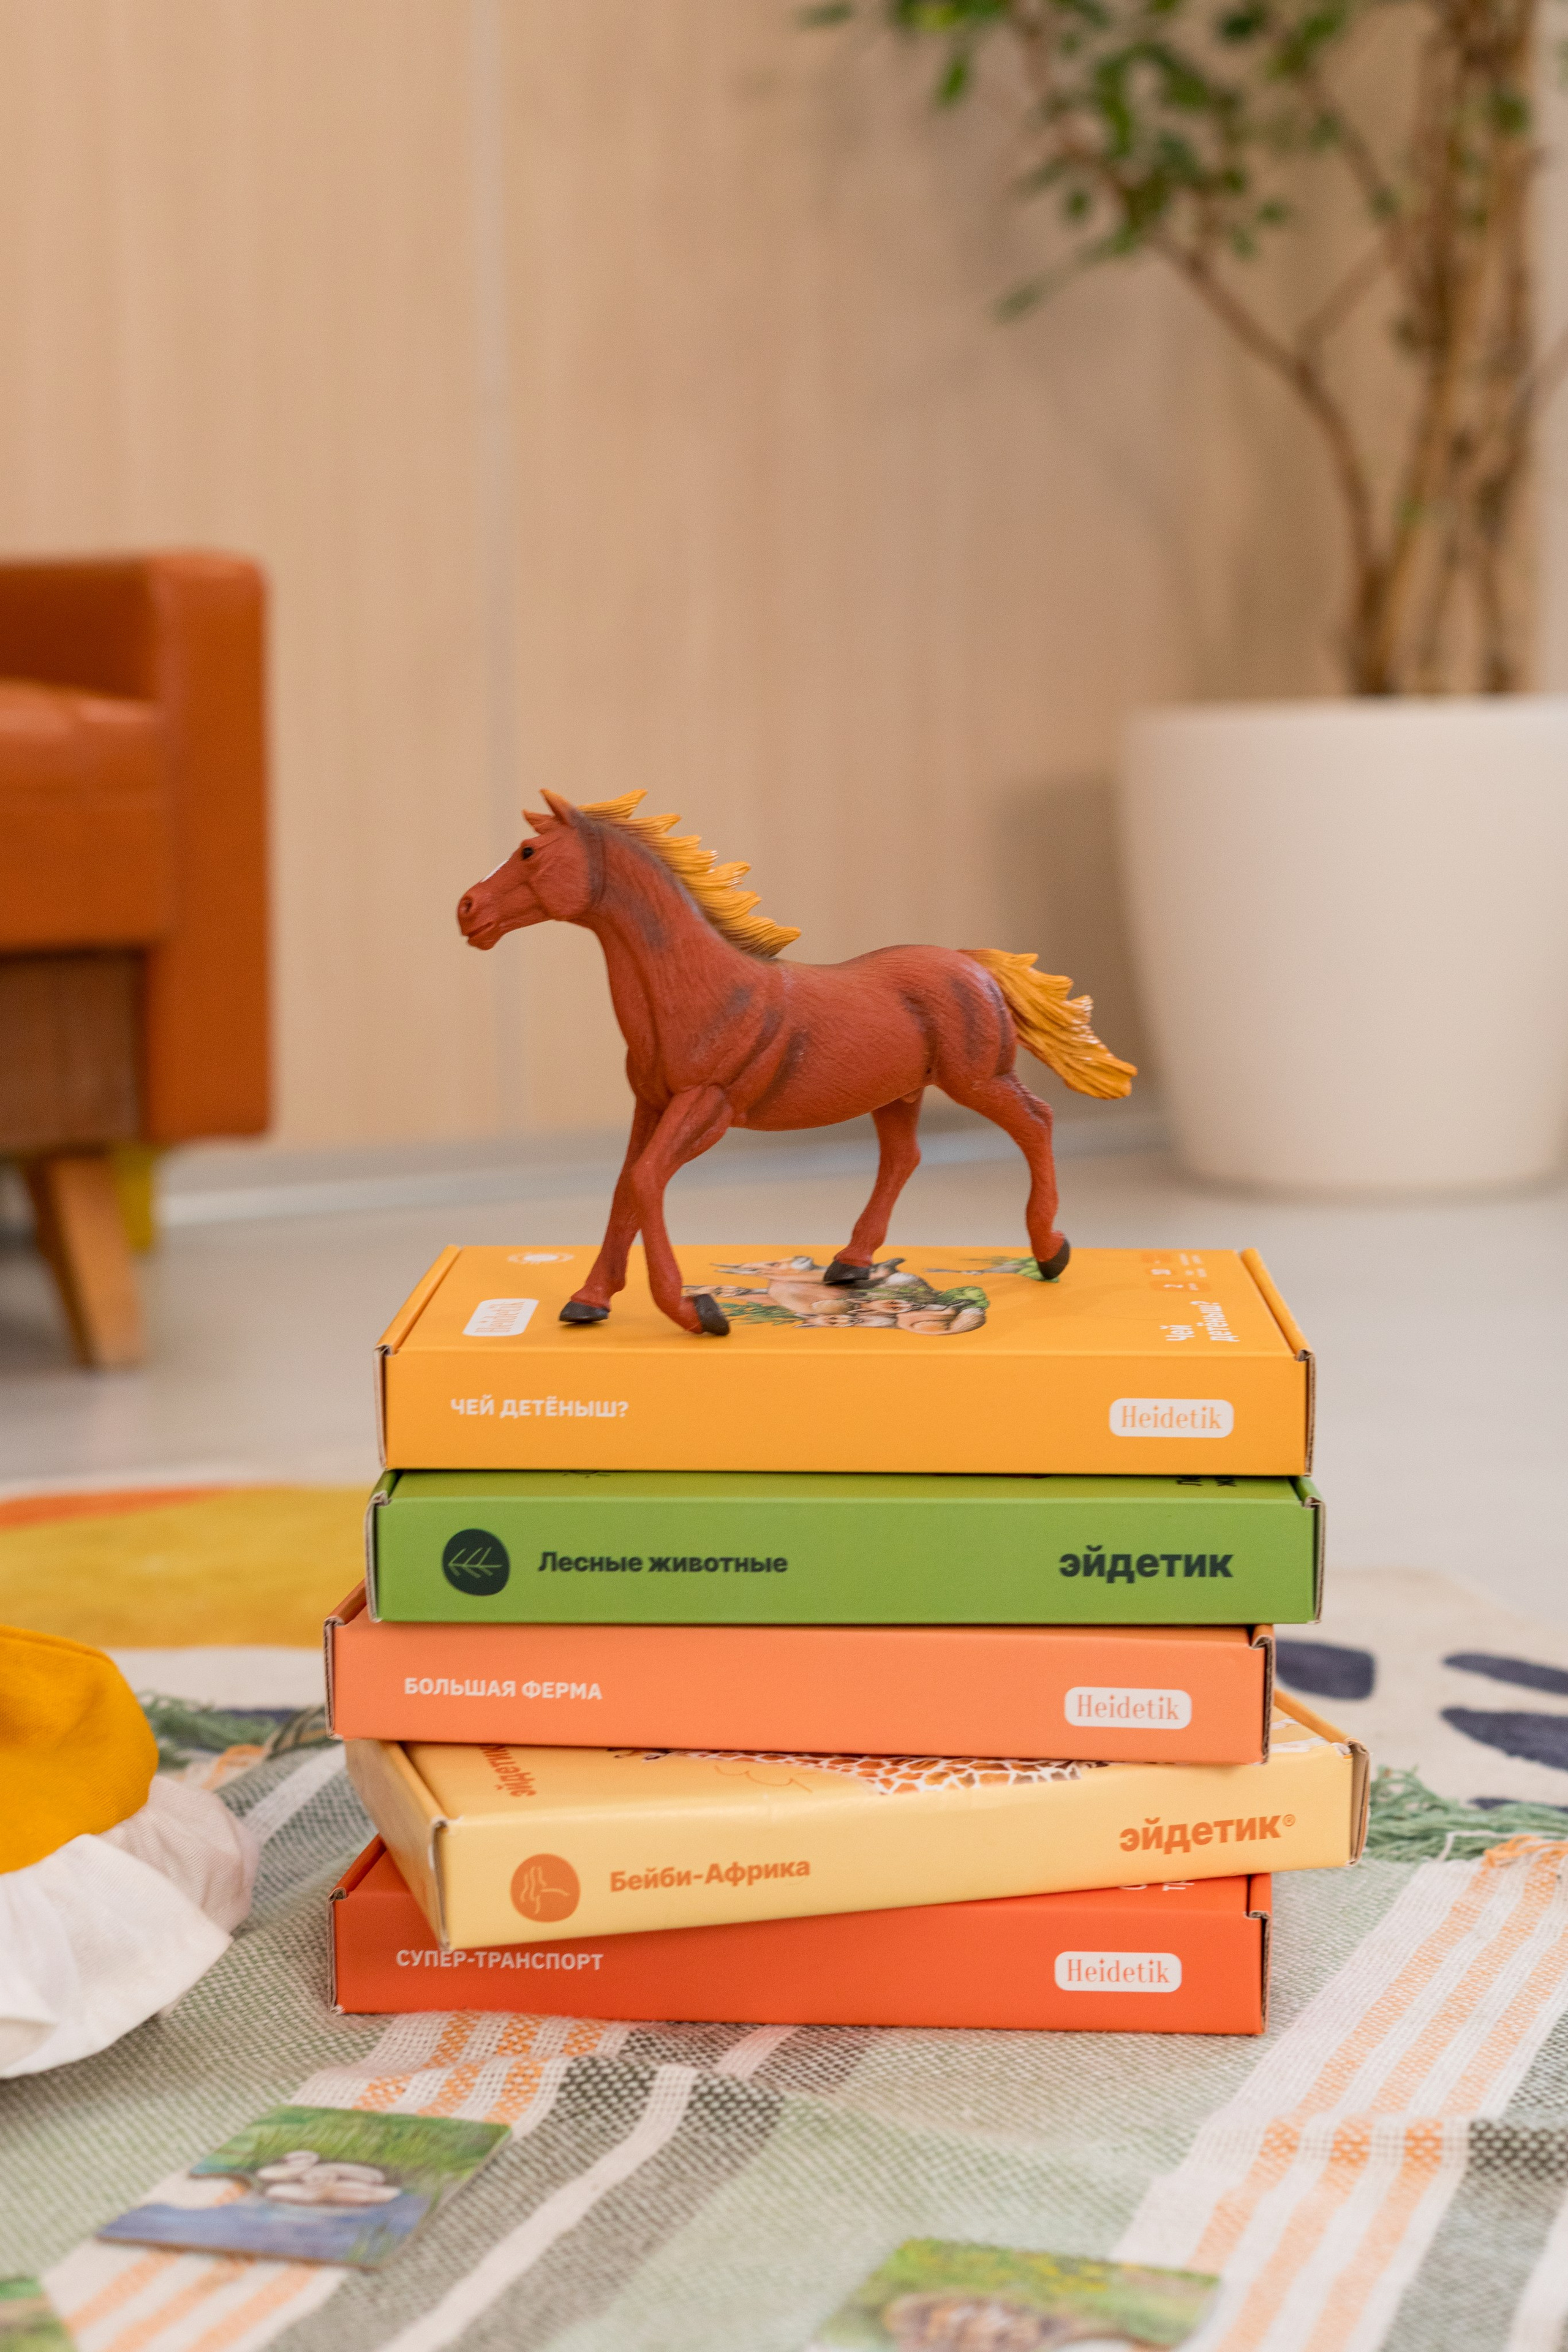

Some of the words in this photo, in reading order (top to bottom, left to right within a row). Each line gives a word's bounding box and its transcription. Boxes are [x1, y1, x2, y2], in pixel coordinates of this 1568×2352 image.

[1159, 1324, 1196, 1341] Чей
[1189, 1300, 1240, 1342] детёныш?
[451, 1395, 494, 1415] ЧЕЙ
[499, 1396, 629, 1419] ДЕТЁНЫШ?
[1121, 1404, 1222, 1430] Heidetik
[538, 1551, 643, 1573] Лесные
[648, 1556, 788, 1573] животные
[1059, 1545, 1234, 1584] эйдетик
[404, 1677, 516, 1698] БОЛЬШАЯ
[521, 1680, 603, 1700] ФЕРМА
[1077, 1694, 1180, 1721] Heidetik
[610, 1858, 811, 1893] Бейби-Африка
[396, 1948, 604, 1971] СУПЕР-ТРАНСПОРТ
[1066, 1959, 1170, 1985] Heidetik
